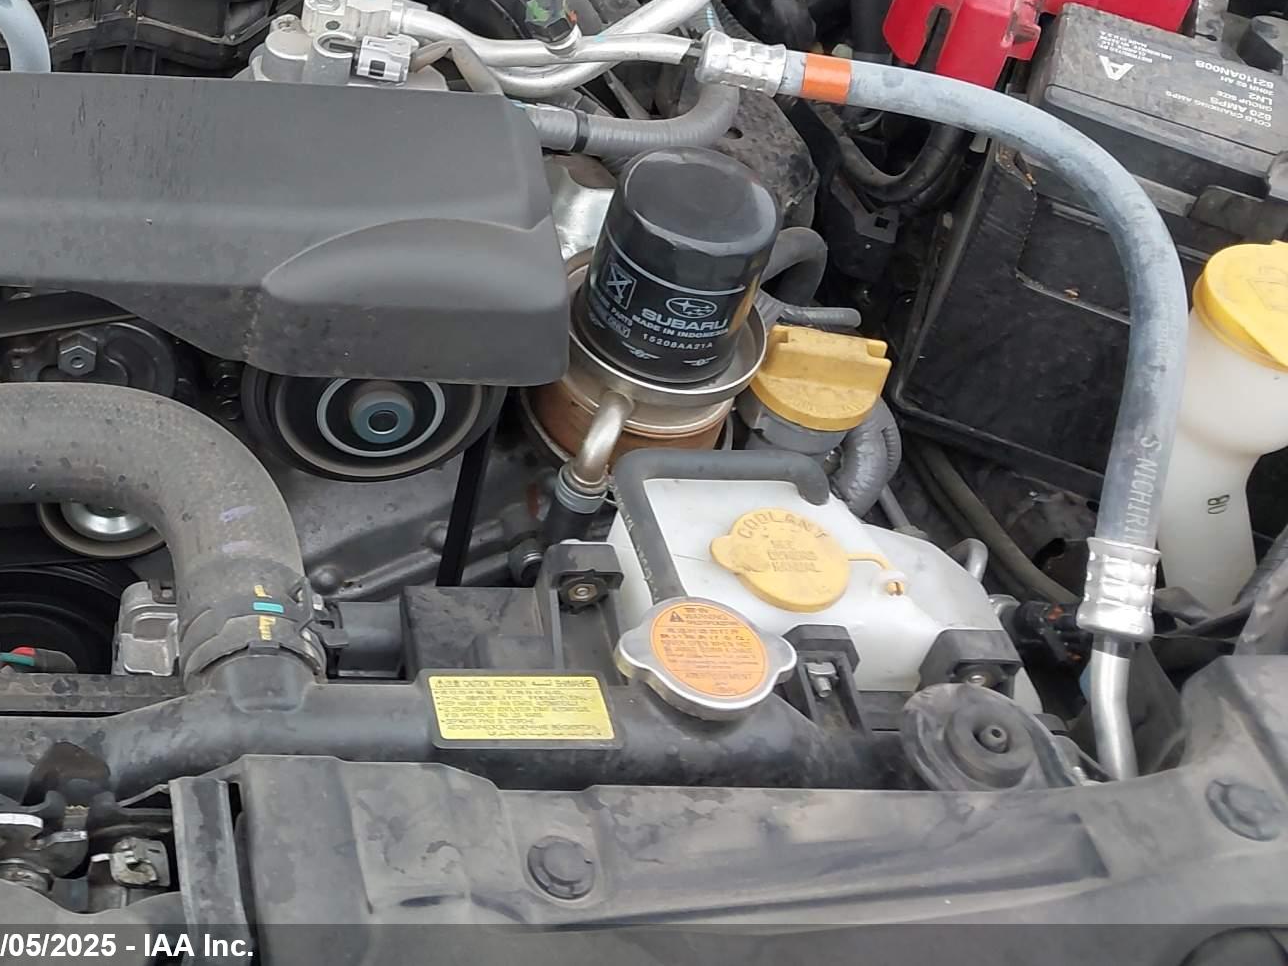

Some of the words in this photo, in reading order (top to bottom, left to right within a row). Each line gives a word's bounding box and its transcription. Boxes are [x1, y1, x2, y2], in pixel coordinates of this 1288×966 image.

[1099, 55, 1135, 81] A
[1165, 90, 1192, 103] AMPS
[1210, 96, 1248, 115] AMPS
[1239, 97, 1273, 112] GROUP
[1248, 92, 1273, 106] LN2
[1243, 114, 1272, 128] COLD
[632, 315, 660, 331] MADE
[663, 327, 675, 337] IN
[642, 308, 729, 332] SUBARU
[737, 511, 829, 539] COOLANT
